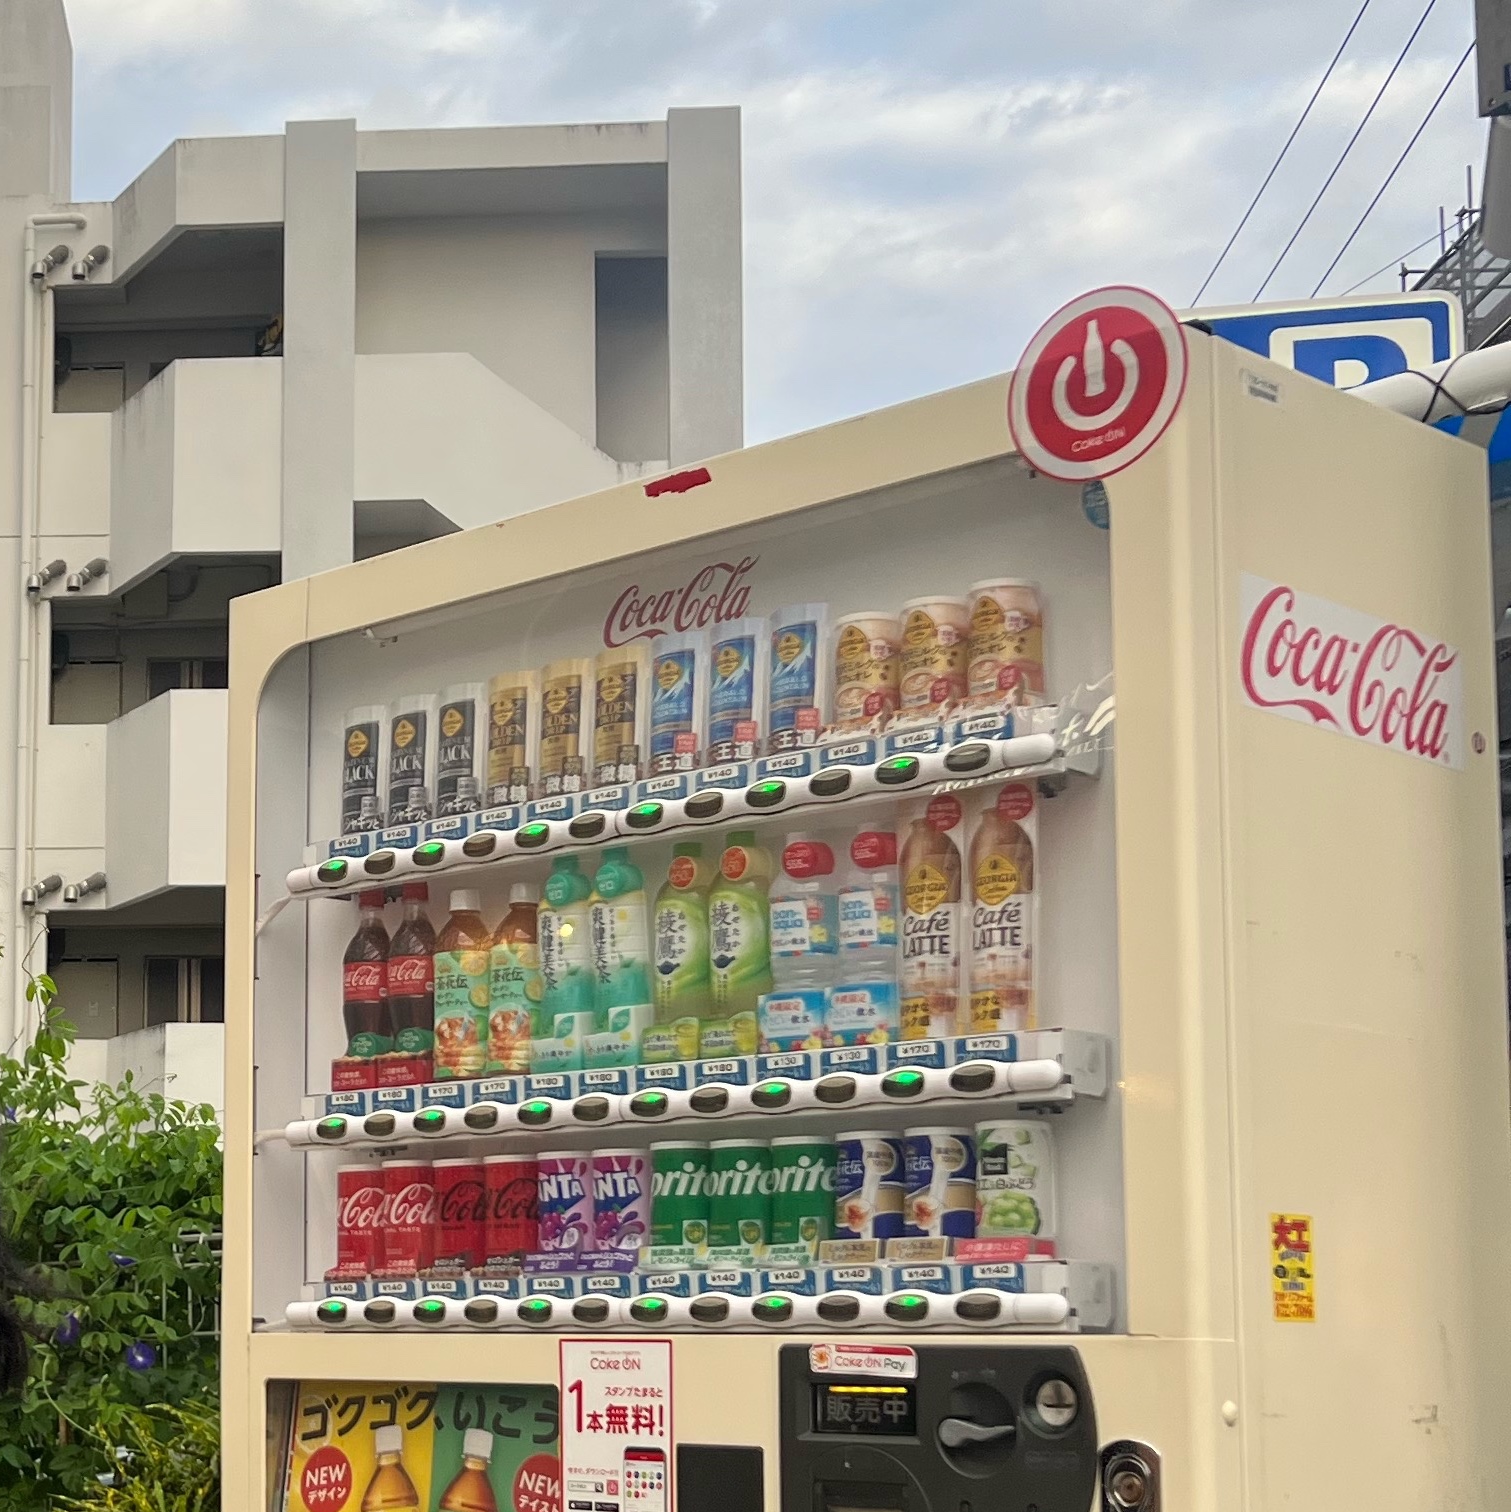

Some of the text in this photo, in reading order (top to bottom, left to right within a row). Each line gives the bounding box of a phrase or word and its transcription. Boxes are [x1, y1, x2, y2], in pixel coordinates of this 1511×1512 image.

[603, 554, 762, 649] Coca-Cola
[1241, 585, 1458, 759] Coca-Cola
[972, 902, 1022, 929] Café
[711, 901, 733, 952] 綾鷹
[903, 910, 951, 937] Café
[658, 908, 679, 960] 綾鷹
[972, 926, 1022, 952] LATTE
[903, 934, 951, 959] LATTE
[971, 1038, 1002, 1049] ¥170
[902, 1044, 930, 1055] ¥170
[773, 1056, 797, 1066] ¥130
[838, 1051, 861, 1062] ¥130
[649, 1067, 674, 1077] ¥180
[708, 1062, 733, 1073] ¥180
[536, 1077, 558, 1086] ¥180
[589, 1073, 613, 1082] ¥180
[432, 1086, 453, 1095] ¥170
[485, 1082, 506, 1091] ¥170
[336, 1094, 355, 1103] ¥180
[382, 1091, 402, 1099] ¥180
[539, 1173, 585, 1202] NTA
[593, 1171, 640, 1201] NTA
[837, 1269, 865, 1279] ¥140
[906, 1269, 936, 1278] ¥140
[979, 1265, 1010, 1275] ¥140
[651, 1276, 676, 1286] ¥140
[711, 1274, 737, 1282] ¥140
[774, 1271, 801, 1281] ¥140
[334, 1284, 354, 1292] ¥140
[383, 1283, 403, 1291] ¥140
[431, 1281, 453, 1290] ¥140
[482, 1280, 505, 1289] ¥140
[537, 1280, 560, 1288] ¥140
[592, 1279, 616, 1287] ¥140
[590, 1355, 641, 1370] Coke ON
[834, 1354, 907, 1373] Coke ON Pay
[604, 1386, 663, 1398] スタンプたまると
[826, 1395, 909, 1424] 販売中
[306, 1462, 347, 1489] NEW
[518, 1470, 560, 1500] NEW
[307, 1486, 347, 1504] デザイン
